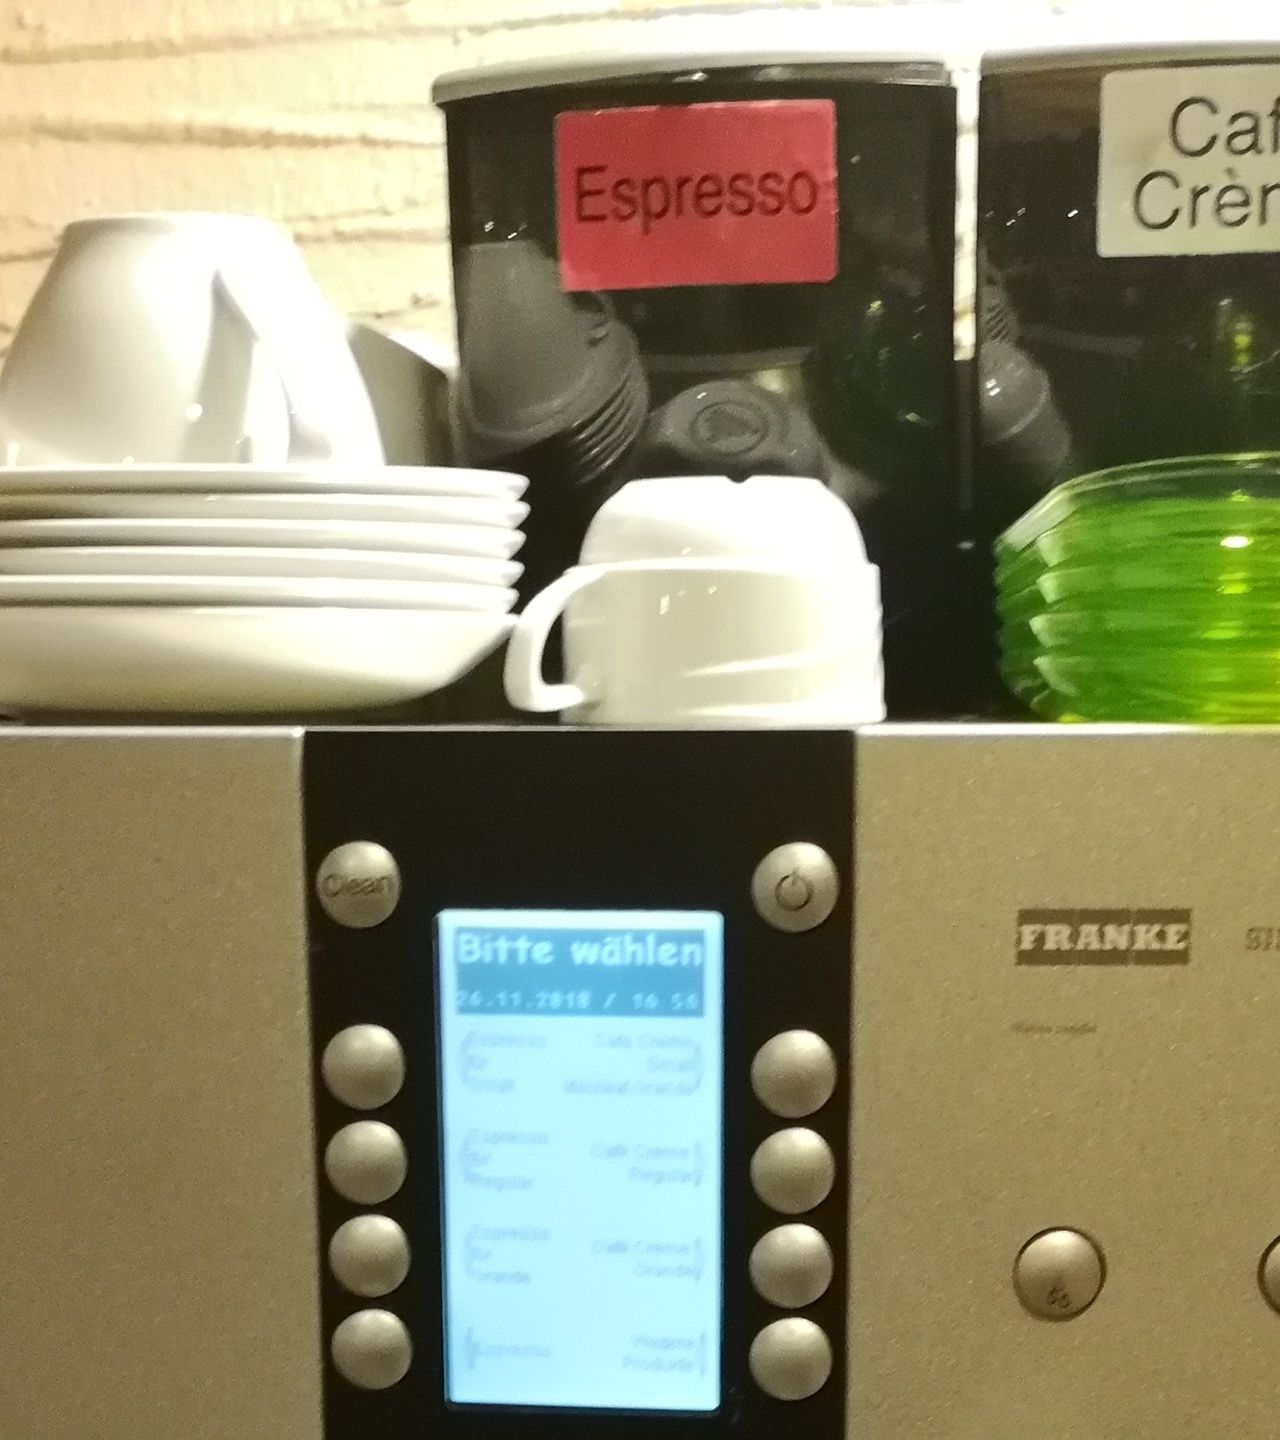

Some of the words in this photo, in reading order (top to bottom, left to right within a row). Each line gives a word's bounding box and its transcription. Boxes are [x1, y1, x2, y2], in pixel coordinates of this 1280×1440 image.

[575, 163, 819, 238] Espresso
[458, 931, 556, 966] Bitte
[570, 931, 704, 967] wählen
[1018, 922, 1190, 952] FRANKE
